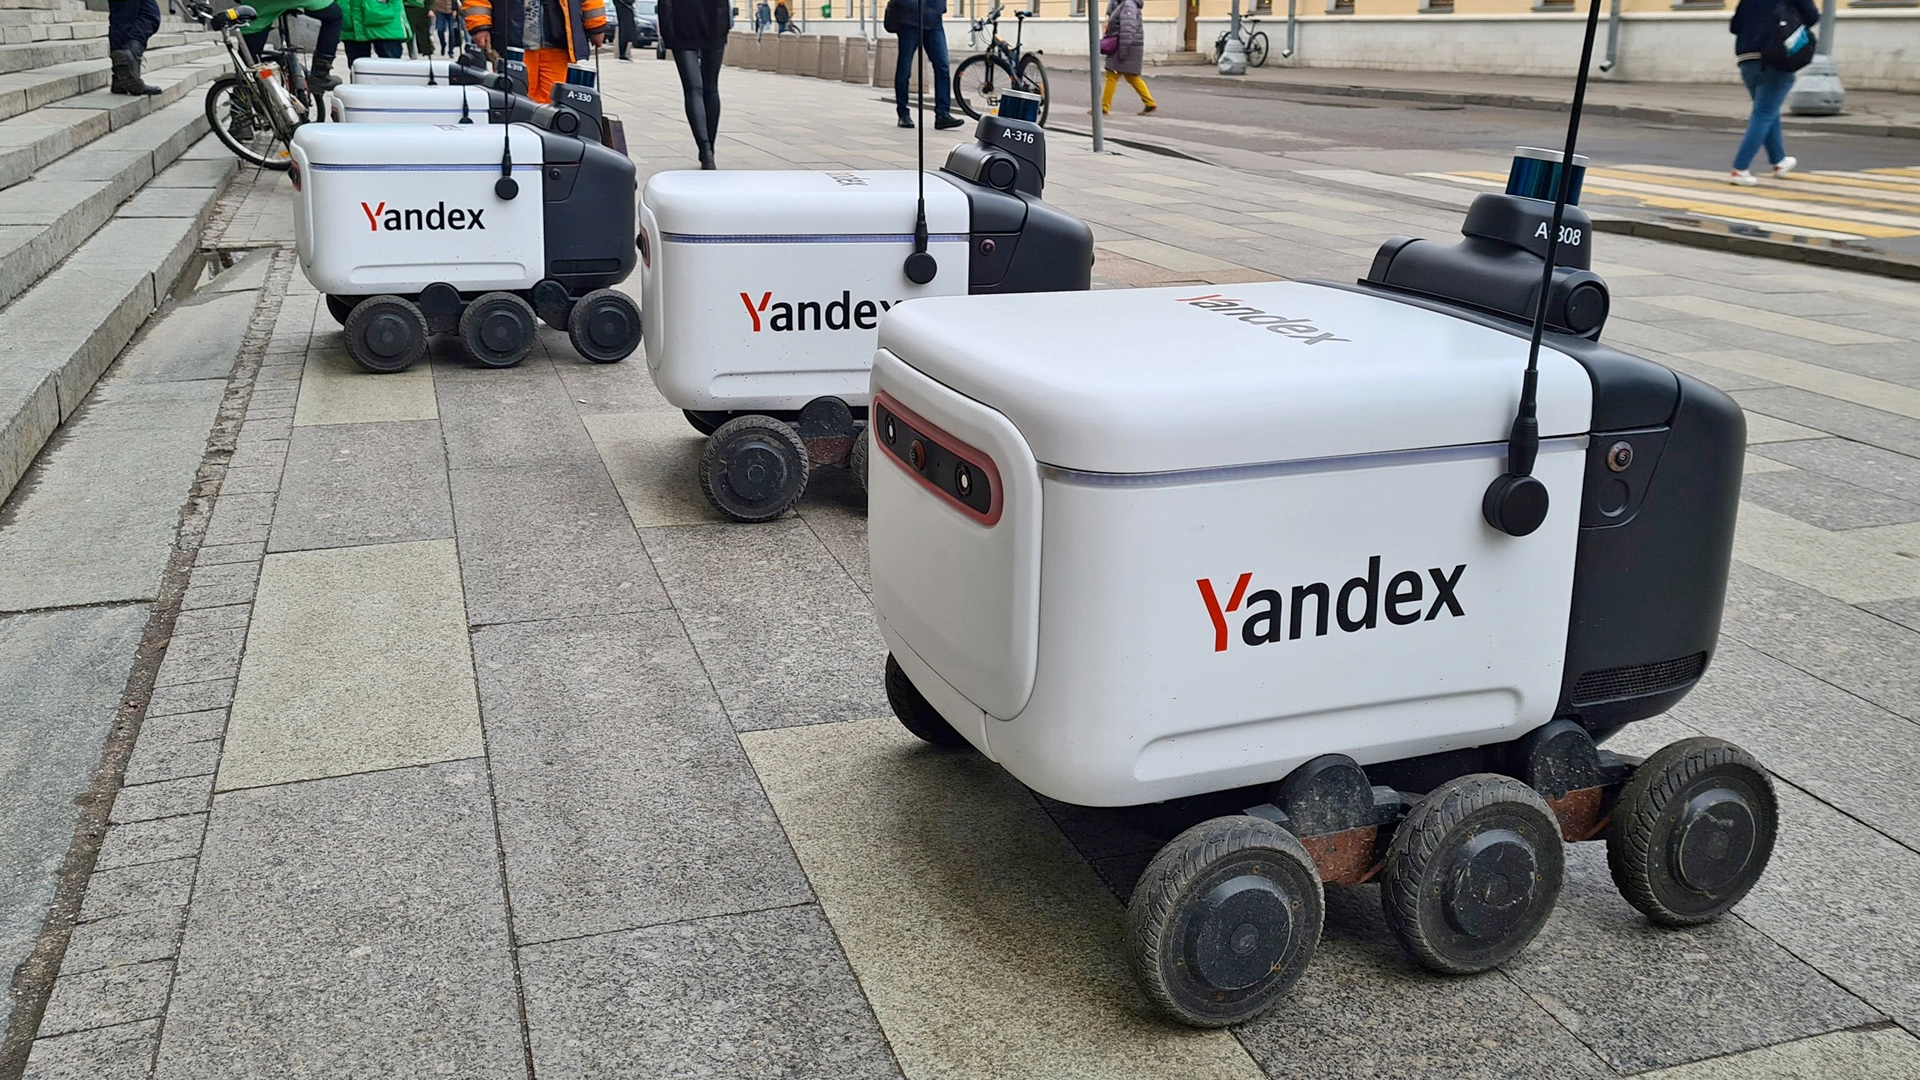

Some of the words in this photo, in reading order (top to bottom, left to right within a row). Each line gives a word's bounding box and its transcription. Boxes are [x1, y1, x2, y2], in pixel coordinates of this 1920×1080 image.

[567, 90, 592, 103] A-330
[1002, 128, 1035, 144] A-316
[360, 201, 486, 231] Yandex
[1174, 294, 1353, 345] Yandex
[1196, 555, 1467, 652] Yandex
